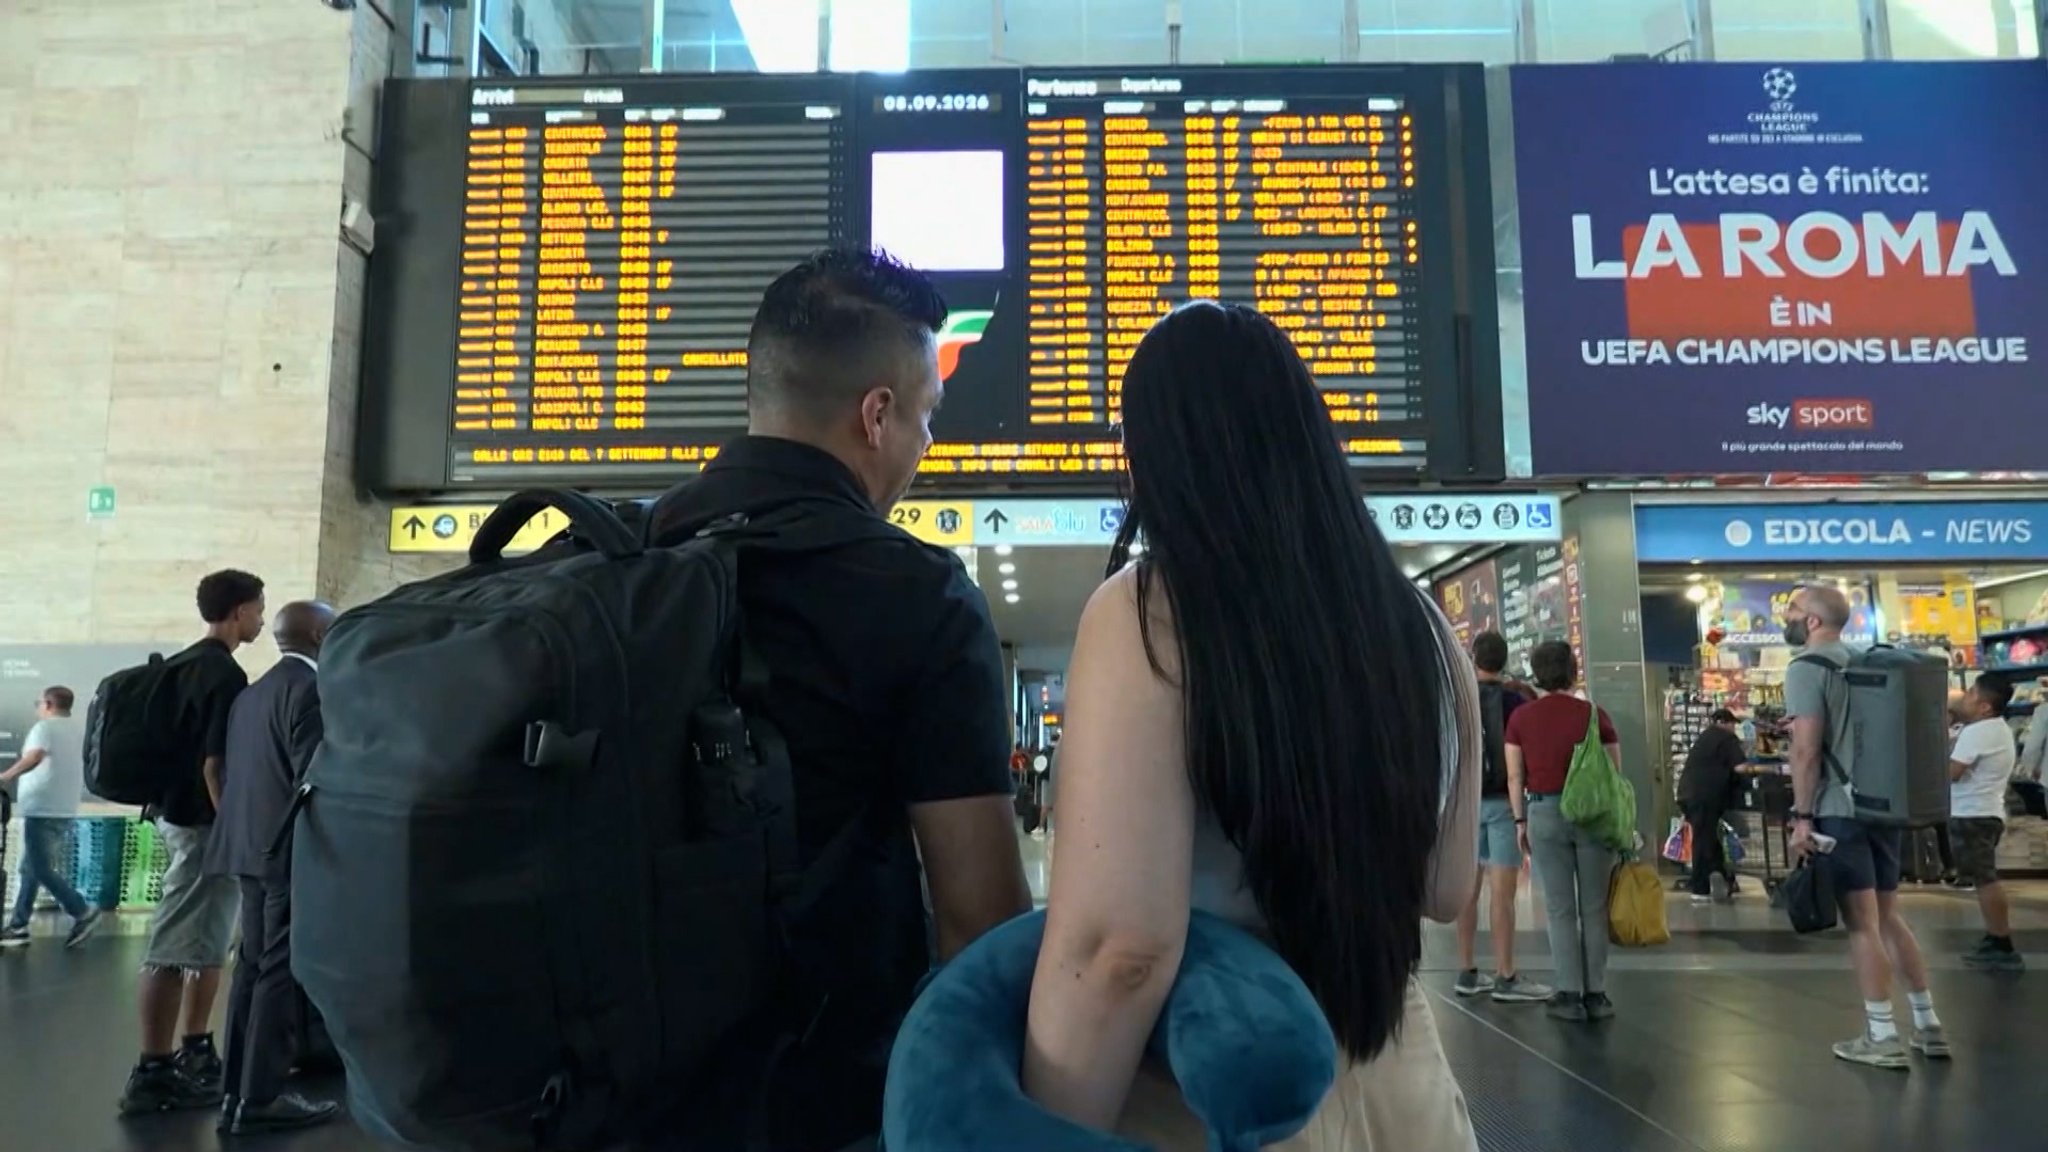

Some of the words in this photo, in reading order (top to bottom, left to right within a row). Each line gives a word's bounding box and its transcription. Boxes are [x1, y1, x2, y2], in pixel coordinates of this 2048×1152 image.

[883, 94, 989, 111] 08.09.2026
[1747, 113, 1819, 122] CHAMPIONS
[545, 126, 607, 140] CIVITAVECC.
[1761, 123, 1808, 132] LEAGUE
[1105, 133, 1168, 146] CIVITAVECC.
[544, 156, 589, 170] CASERTA
[1274, 162, 1327, 174] CENTRALE
[1650, 167, 1790, 196] L'attesa
[1797, 167, 1819, 195] è
[1826, 166, 1929, 195] finita:
[542, 201, 581, 215] ALBANO
[1106, 208, 1169, 221] CIVITAVECC.
[1297, 207, 1353, 219] LADISPOLI
[1107, 224, 1144, 237] MILANO
[1107, 239, 1153, 252] BOLZANO
[1572, 213, 1702, 279] LA
[1719, 211, 2017, 278] ROMA
[1107, 270, 1145, 282] NAPOLI
[1284, 269, 1323, 280] NAPOLI
[538, 277, 576, 290] NAPOLI
[1318, 284, 1367, 296] CIAMPINO
[537, 308, 576, 321] LATINA
[1769, 295, 1791, 325] È
[1797, 302, 1832, 325] IN
[536, 339, 581, 352] PERUGIA
[1581, 339, 1671, 366] UEFA
[1676, 338, 1887, 365] CHAMPIONS
[1891, 336, 2028, 363] LEAGUE
[682, 353, 747, 365] CANCELLATO
[535, 370, 573, 383] NAPOLI
[534, 386, 579, 398] PERUGIA
[533, 401, 590, 414] LADISPOLI
[1746, 401, 1791, 429] sky
[1799, 403, 1868, 427] sport
[533, 418, 571, 430] NAPOLI
[1023, 443, 1067, 456] RITARDI
[1722, 441, 1728, 451] Il
[1730, 441, 1746, 452] più
[1748, 441, 1786, 452] grande
[1788, 441, 1846, 452] spettacolo
[1848, 440, 1864, 451] del
[1866, 440, 1904, 451] mondo
[894, 508, 921, 525] 29
[1765, 518, 1912, 545] EDICOLA
[1946, 519, 2032, 544] NEWS
